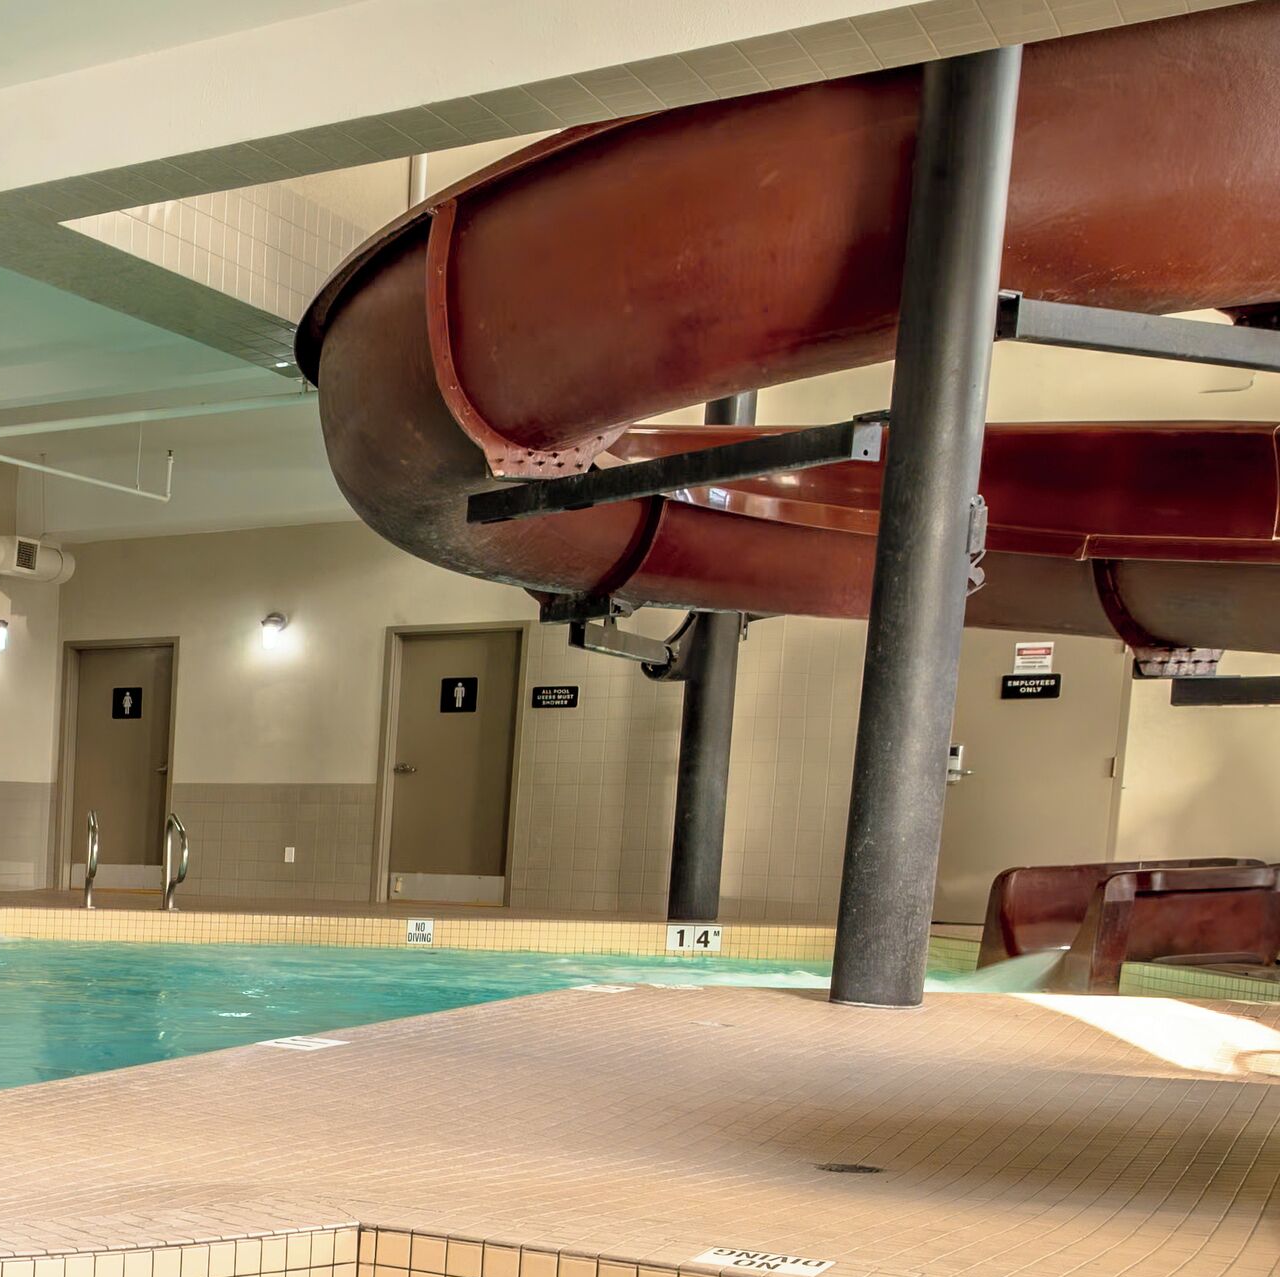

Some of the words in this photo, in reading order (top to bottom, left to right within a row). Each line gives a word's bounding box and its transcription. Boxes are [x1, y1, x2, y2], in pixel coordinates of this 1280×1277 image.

[1007, 679, 1055, 687] EMPLOYEES
[415, 922, 425, 932] NO
[407, 932, 431, 942] DIVING
[713, 1249, 826, 1267] DIVING
[733, 1259, 782, 1270] NO
